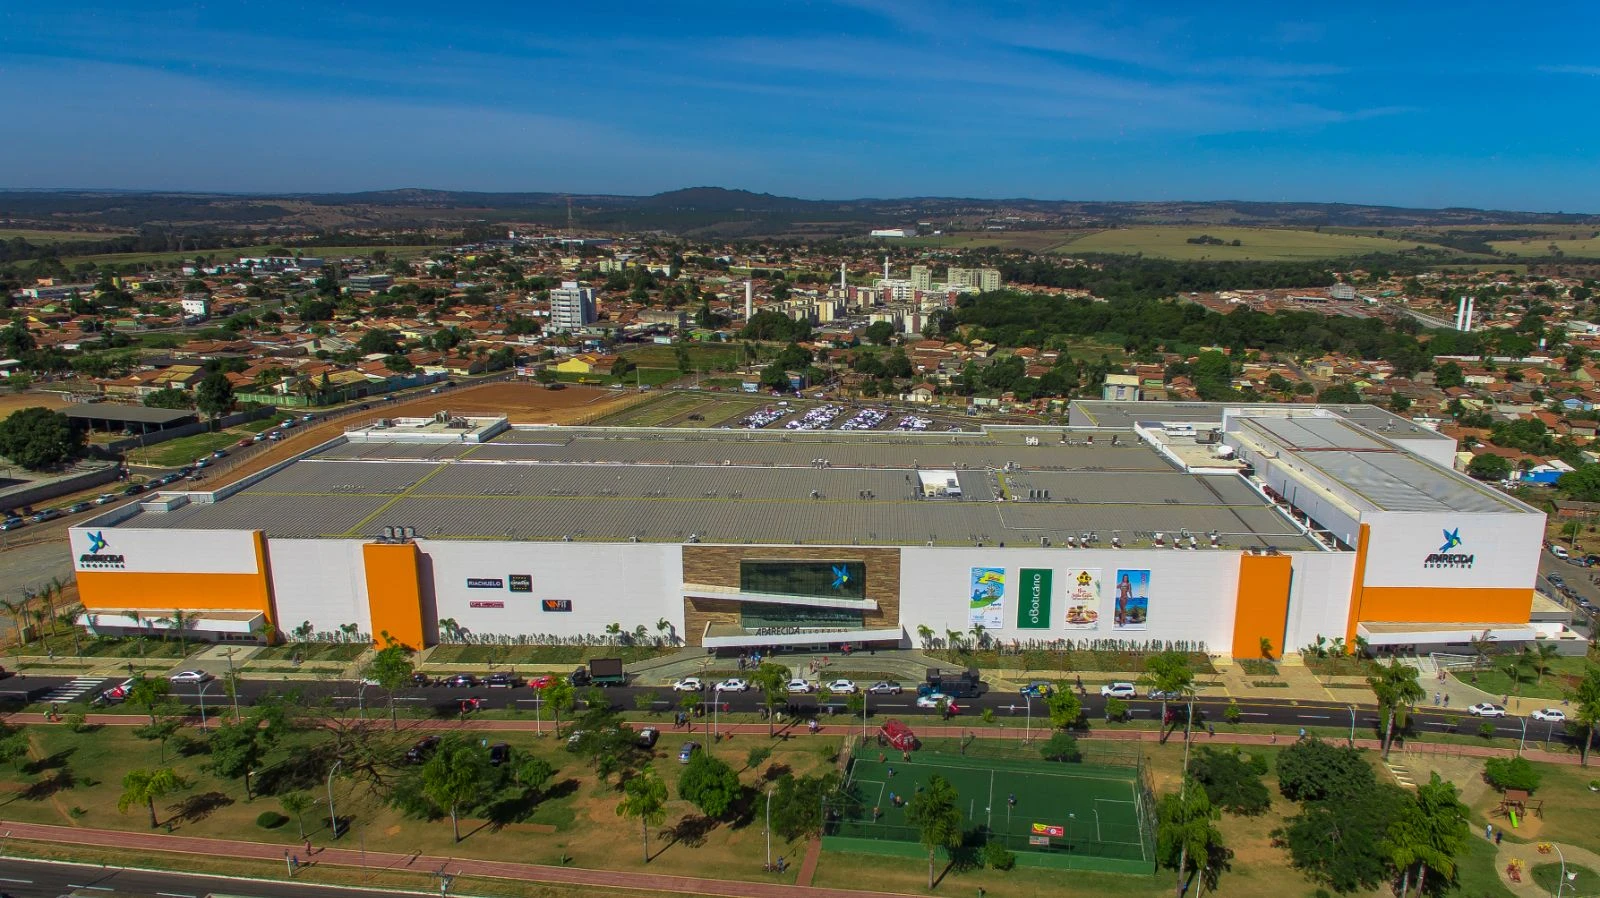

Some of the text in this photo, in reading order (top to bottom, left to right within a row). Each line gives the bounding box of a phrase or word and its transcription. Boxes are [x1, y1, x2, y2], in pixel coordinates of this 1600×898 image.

[1424, 553, 1475, 564] APARECIDA
[468, 580, 502, 588] RIACHUELO
[755, 626, 800, 637] APARECIDA
